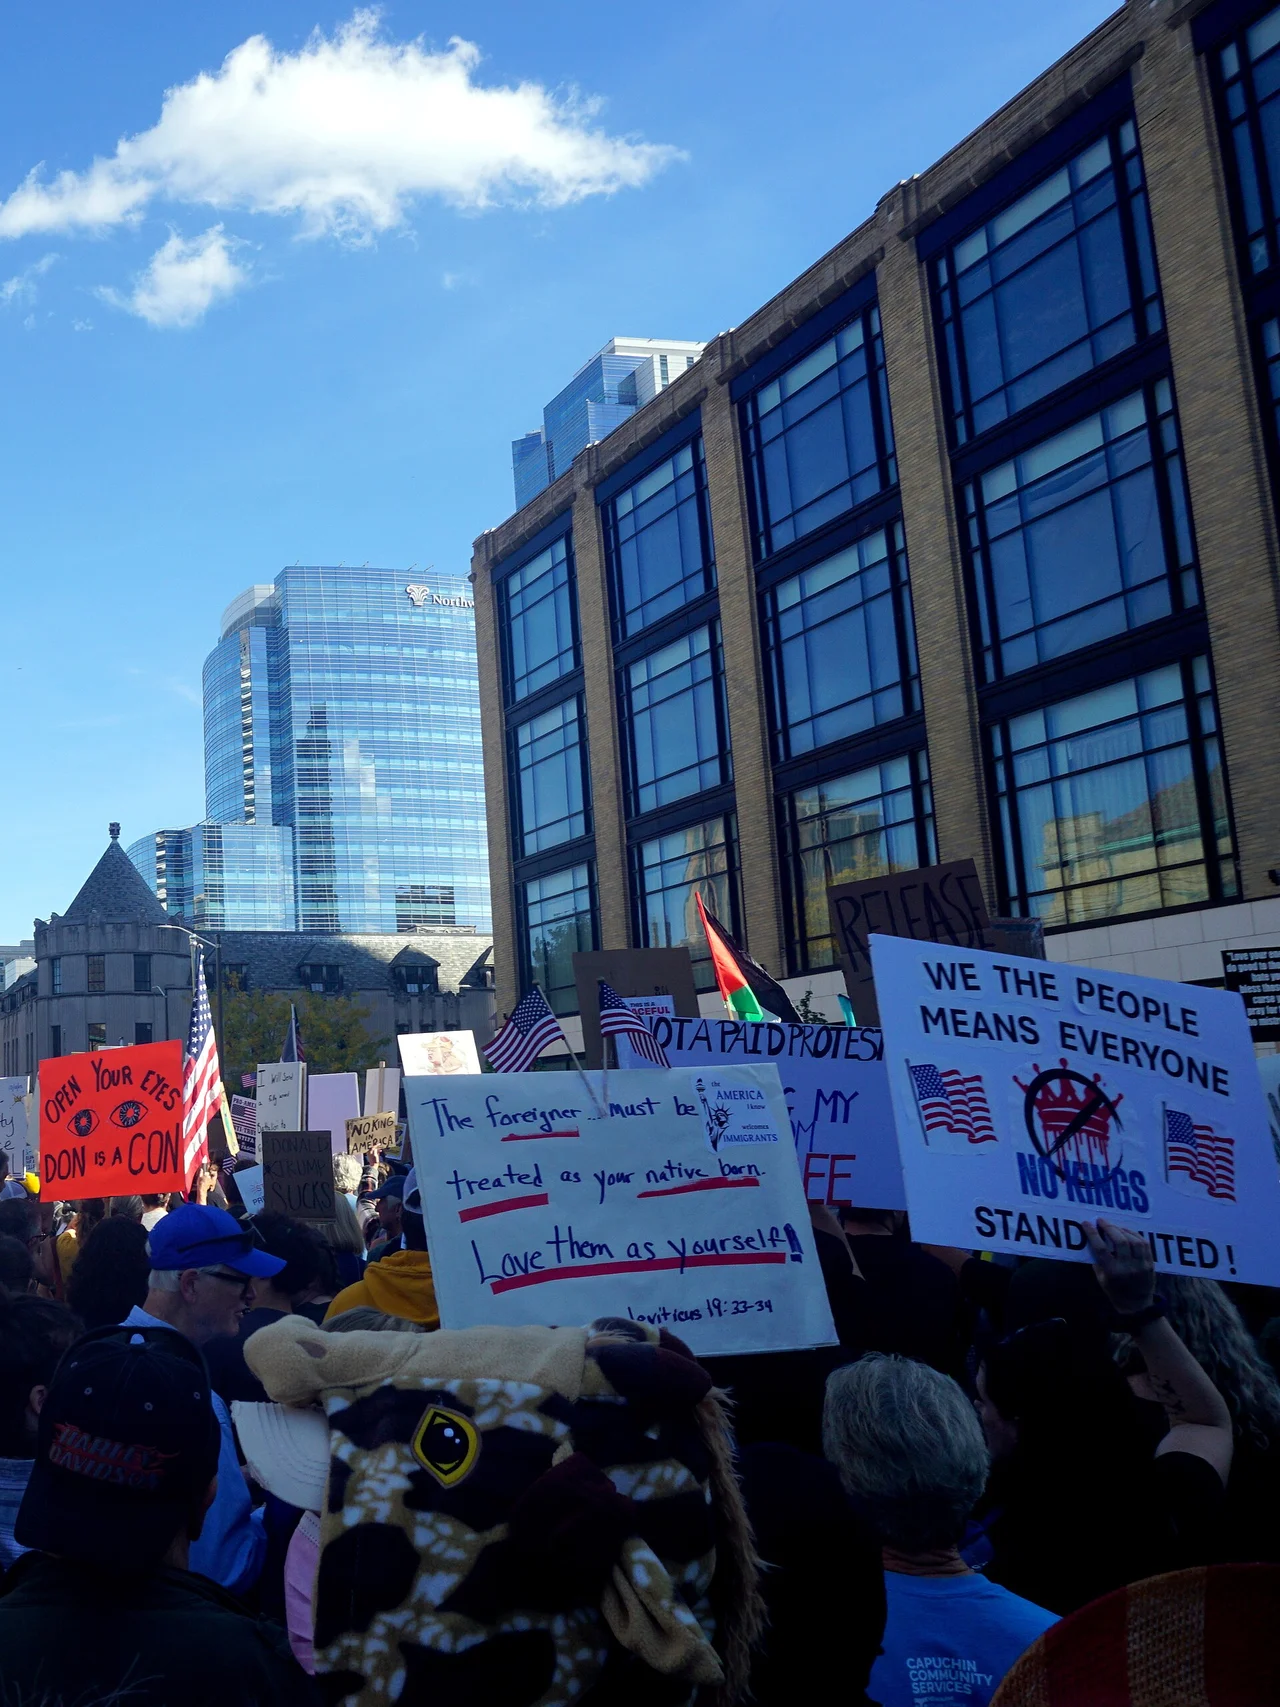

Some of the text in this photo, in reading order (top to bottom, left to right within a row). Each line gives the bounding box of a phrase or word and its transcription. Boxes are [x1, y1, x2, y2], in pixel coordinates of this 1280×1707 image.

[631, 1007, 671, 1016] ACEFUL
[923, 962, 1200, 1037] WE THE PEOPLE
[689, 1018, 712, 1052] A
[715, 1020, 786, 1056] PAID
[920, 1005, 1230, 1097] MEANS EVERYONE
[45, 1058, 181, 1123] OPEN YOUR EYES
[257, 1069, 266, 1087] I
[716, 1090, 764, 1100] AMERICA
[815, 1088, 860, 1124] MY
[351, 1116, 394, 1137] NO KING
[421, 1097, 474, 1137] The
[609, 1097, 660, 1118] must
[673, 1096, 699, 1116] be
[44, 1145, 86, 1183] DON
[94, 1150, 106, 1166] IS
[112, 1146, 122, 1166] A
[128, 1122, 180, 1175] CON
[351, 1135, 393, 1154] AMERICA
[723, 1134, 778, 1142] IMMIGRANTS
[272, 1181, 332, 1212] SUCKS
[446, 1163, 543, 1200] treated
[560, 1170, 581, 1183] as
[594, 1170, 635, 1204] your
[646, 1160, 709, 1183] native
[1016, 1152, 1150, 1213] NO KINGS
[974, 1206, 1088, 1251] STAND
[471, 1239, 545, 1284] Love
[546, 1225, 614, 1264] them
[626, 1242, 656, 1260] as
[706, 1297, 774, 1317] 19:33-34
[906, 1657, 977, 1672] CAPUCHIN
[909, 1669, 993, 1686] COMMUNITY
[912, 1681, 972, 1695] SERVICES
